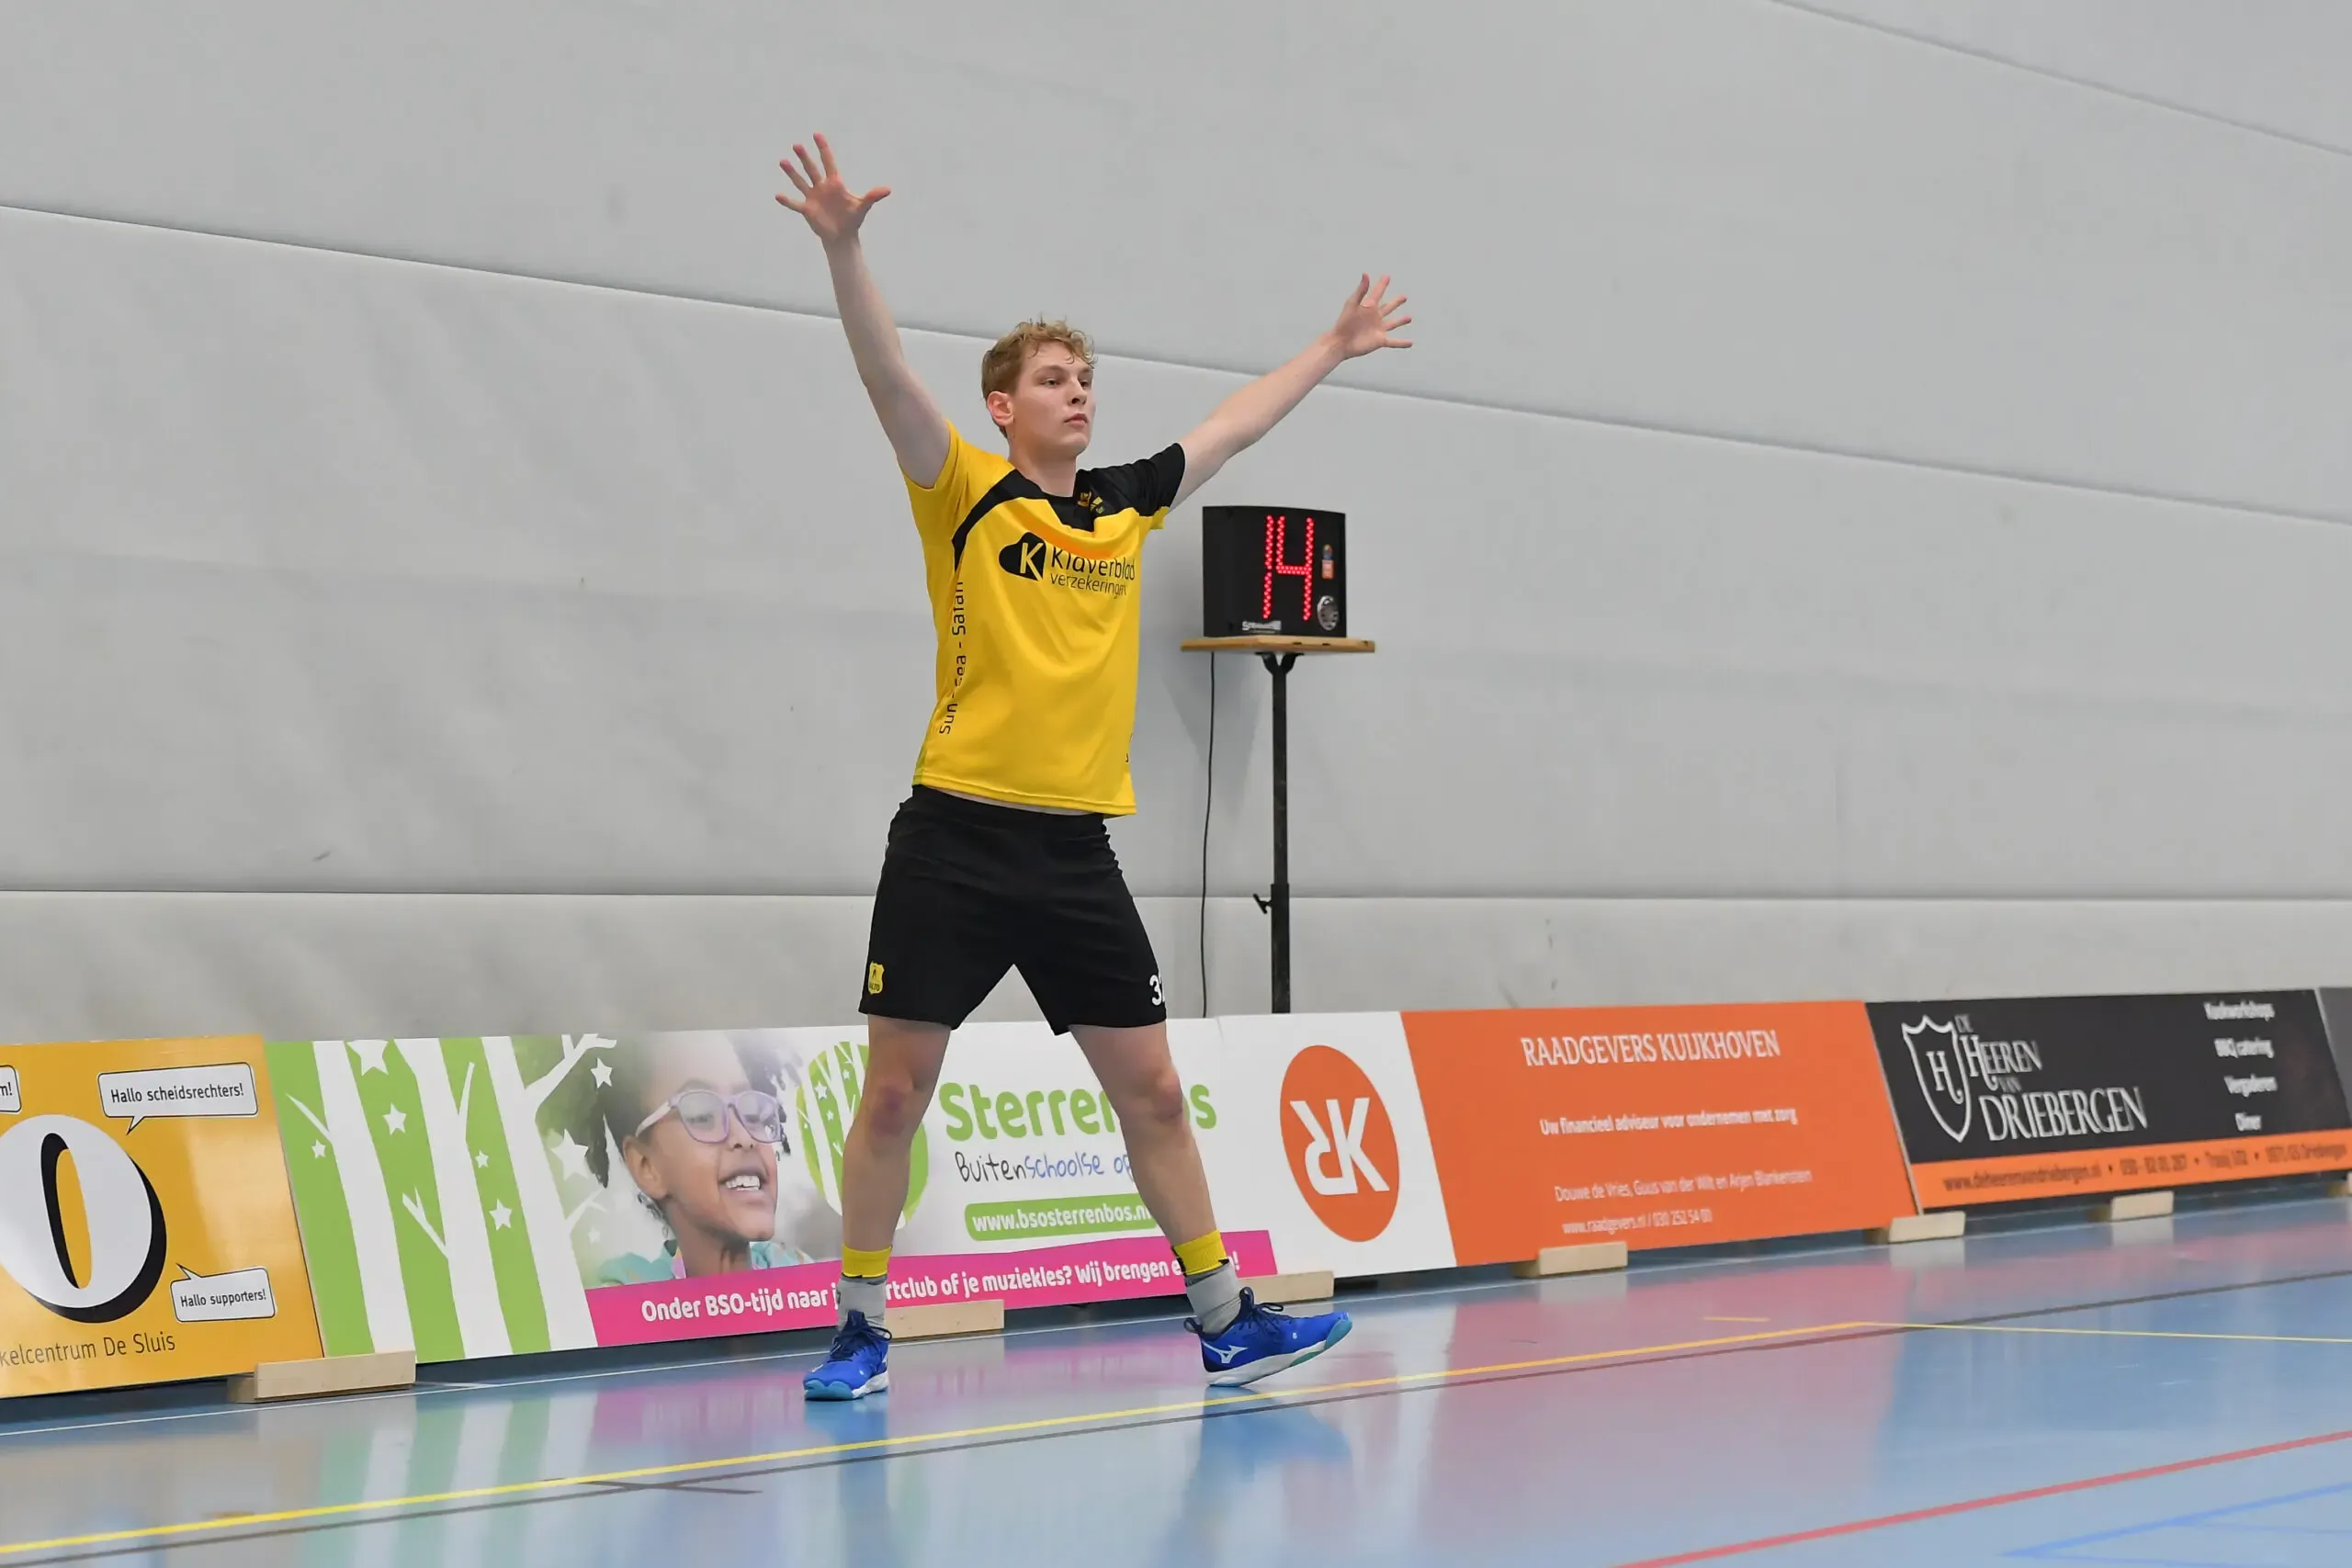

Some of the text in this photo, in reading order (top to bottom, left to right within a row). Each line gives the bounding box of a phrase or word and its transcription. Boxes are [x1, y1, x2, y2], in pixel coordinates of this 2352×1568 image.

[1020, 542, 1045, 581] K
[1262, 514, 1314, 621] 14
[939, 703, 958, 735] Sun
[1521, 1032, 1657, 1066] RAADGEVERS
[1959, 1034, 2043, 1091] HEEREN
[110, 1082, 244, 1103] Hallo scheidsrechters!
[1926, 1051, 1964, 1105] H
[938, 1082, 1217, 1142] Sterres
[1540, 1108, 1798, 1135] Uw financieel adviseur voor ondernemen met zorg
[1978, 1087, 2148, 1141] DRIEBERGEN
[955, 1151, 1104, 1183] Buitenschoolse
[180, 1288, 267, 1308] Hallo supporters!
[640, 1296, 701, 1322] Onder
[704, 1288, 783, 1316] BSO-tijd
[787, 1289, 828, 1310] naar
[885, 1272, 938, 1301] rtclub
[941, 1273, 960, 1297] of
[961, 1271, 979, 1298] je
[982, 1265, 1073, 1292] muziekles?
[1074, 1260, 1102, 1287] Wij
[1103, 1258, 1171, 1284] brengen
[0, 1330, 175, 1368] kelcentrum De Sluis
